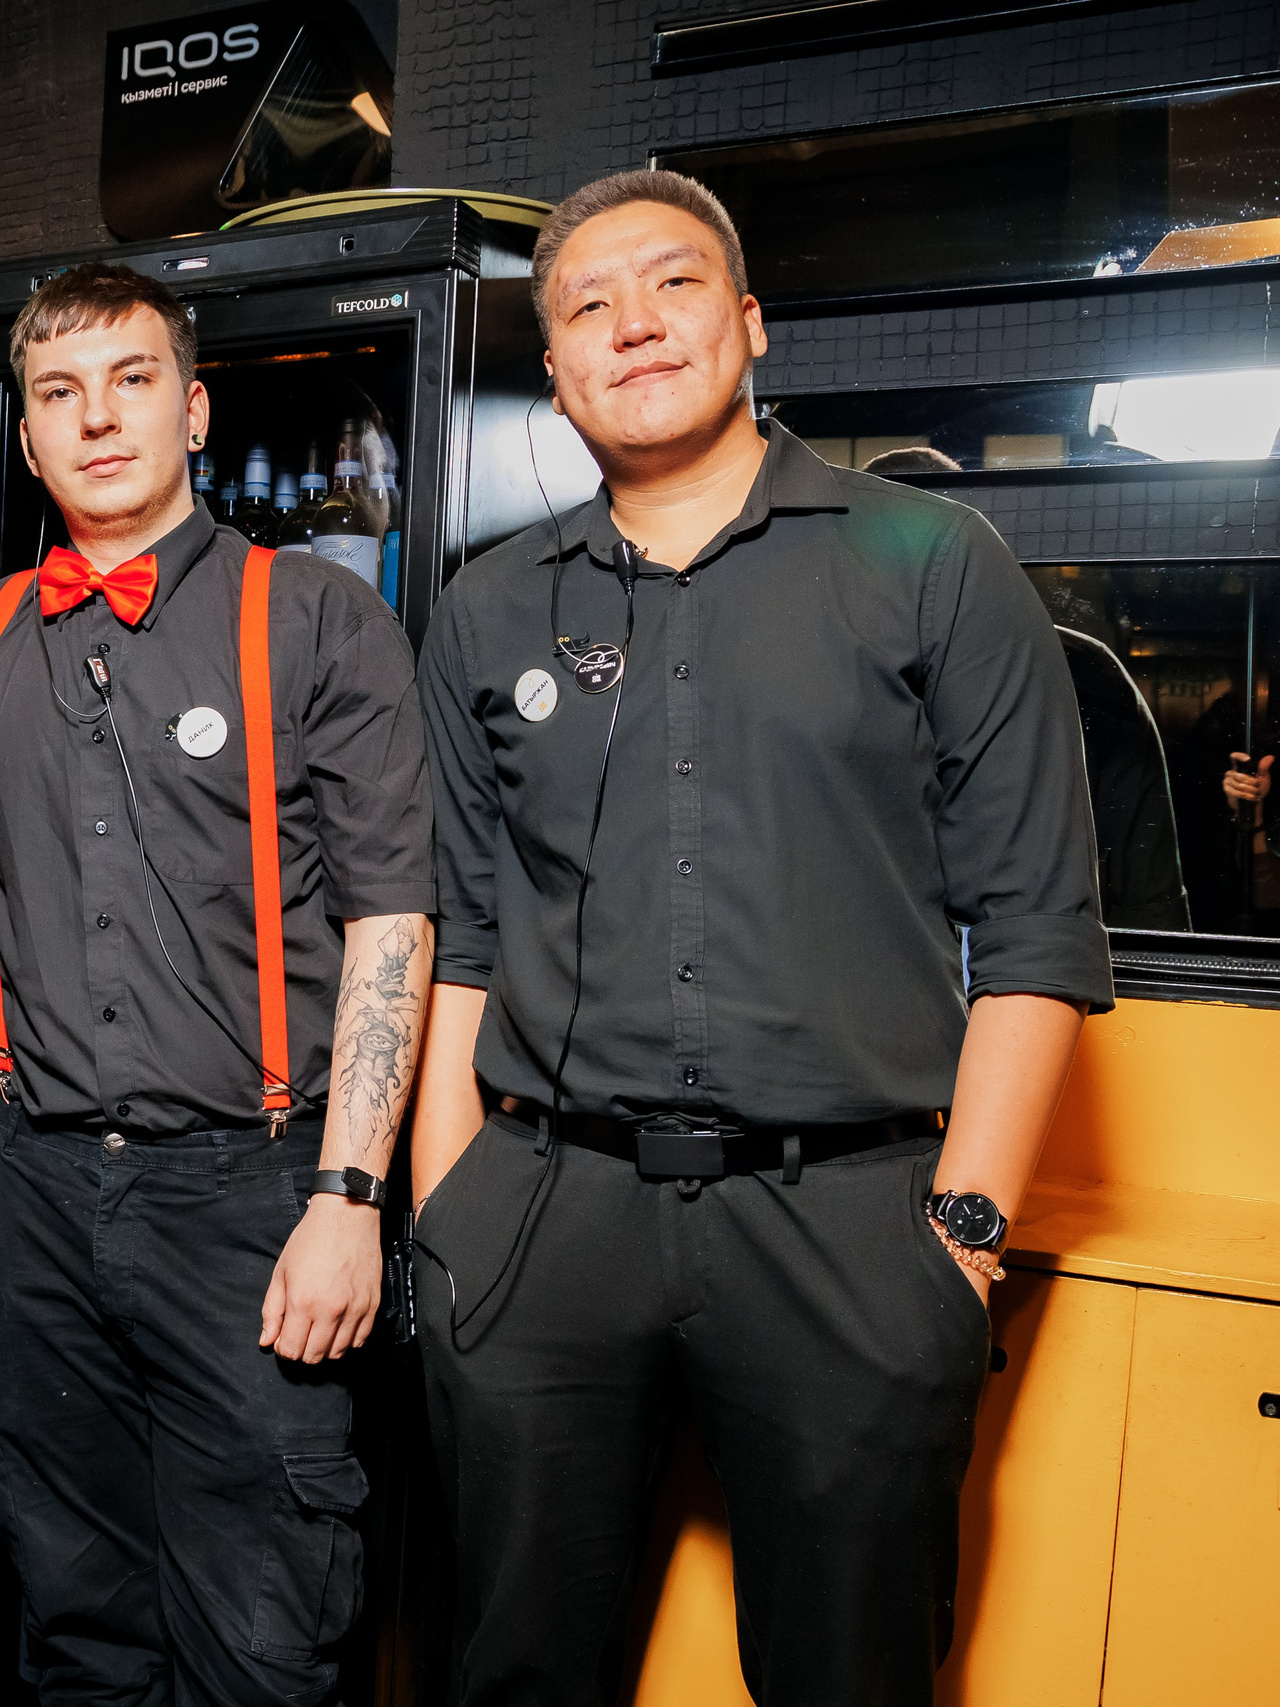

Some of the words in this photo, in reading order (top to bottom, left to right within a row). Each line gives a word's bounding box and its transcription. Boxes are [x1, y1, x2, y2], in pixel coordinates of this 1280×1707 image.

[121, 23, 260, 81] IQOS
[121, 82, 173, 104] қызметі
[180, 75, 228, 95] сервис
[336, 298, 390, 314] TEFCOLD
[521, 679, 549, 711] БАТЫРЖАН
[188, 721, 214, 743] ДАНИК
